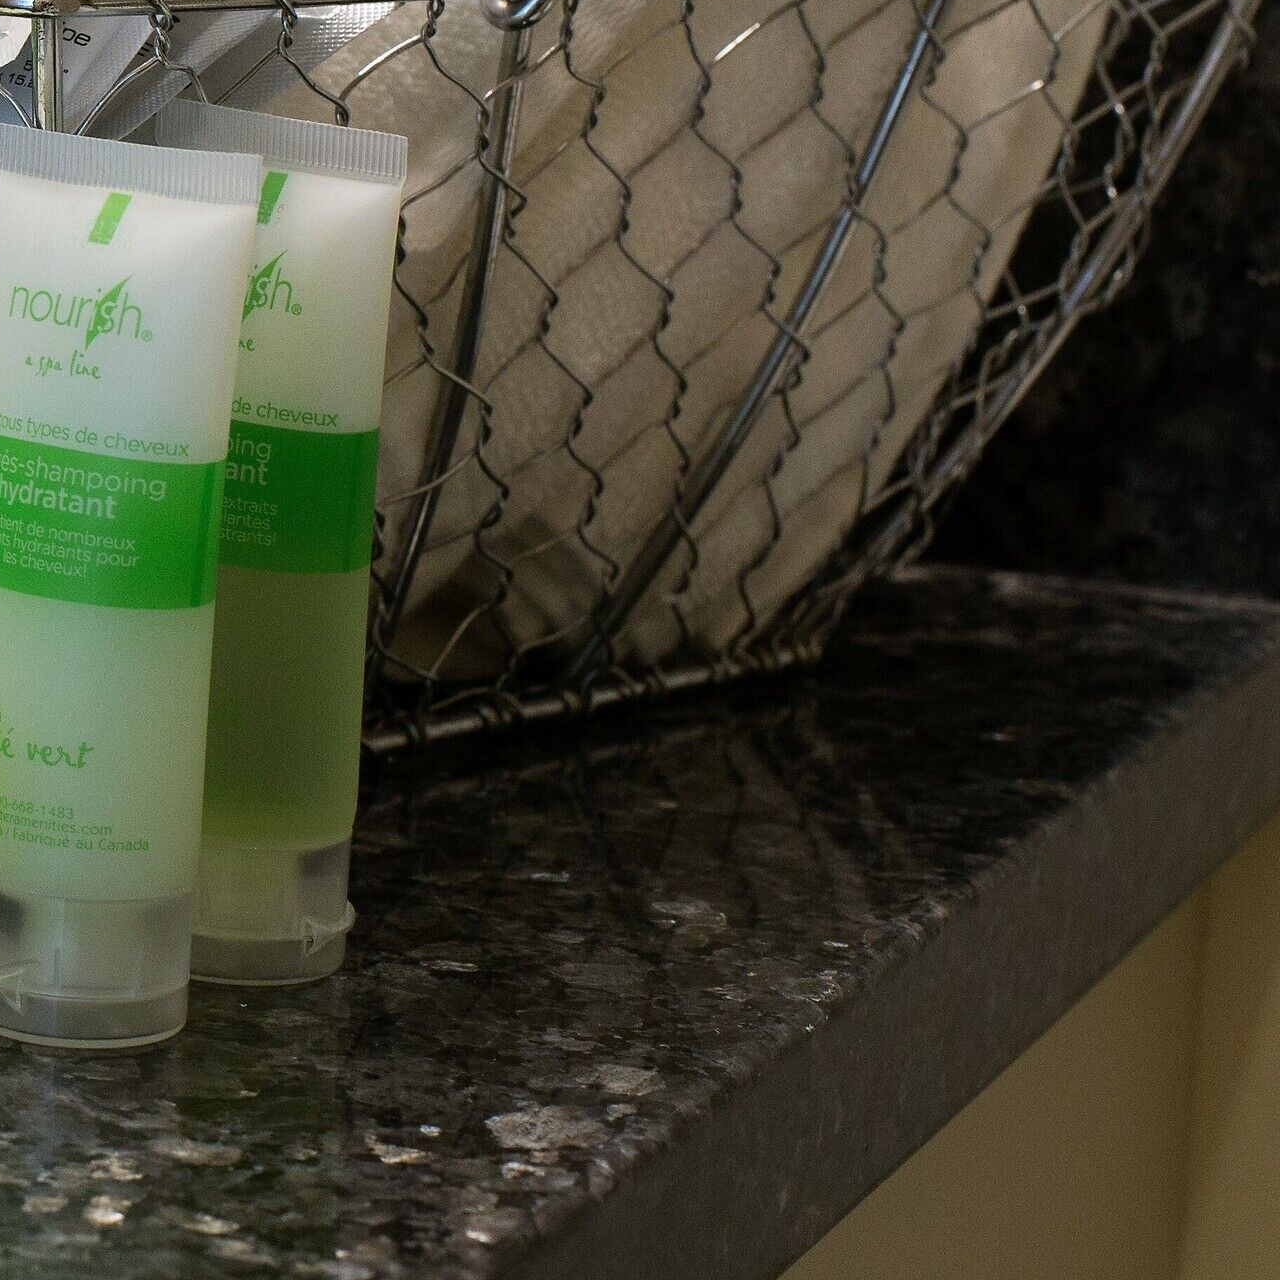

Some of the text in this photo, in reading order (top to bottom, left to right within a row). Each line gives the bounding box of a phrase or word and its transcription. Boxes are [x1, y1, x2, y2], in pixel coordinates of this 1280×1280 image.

[9, 282, 143, 342] nourish
[69, 350, 102, 379] line
[256, 401, 339, 428] cheveux
[26, 418, 70, 442] types
[75, 425, 99, 447] de
[103, 432, 191, 458] cheveux
[13, 533, 91, 563] hydratants
[96, 551, 140, 568] pour
[26, 522, 46, 538] de
[48, 525, 137, 552] nombreux
[2, 548, 18, 566] les
[27, 741, 94, 769] vert
